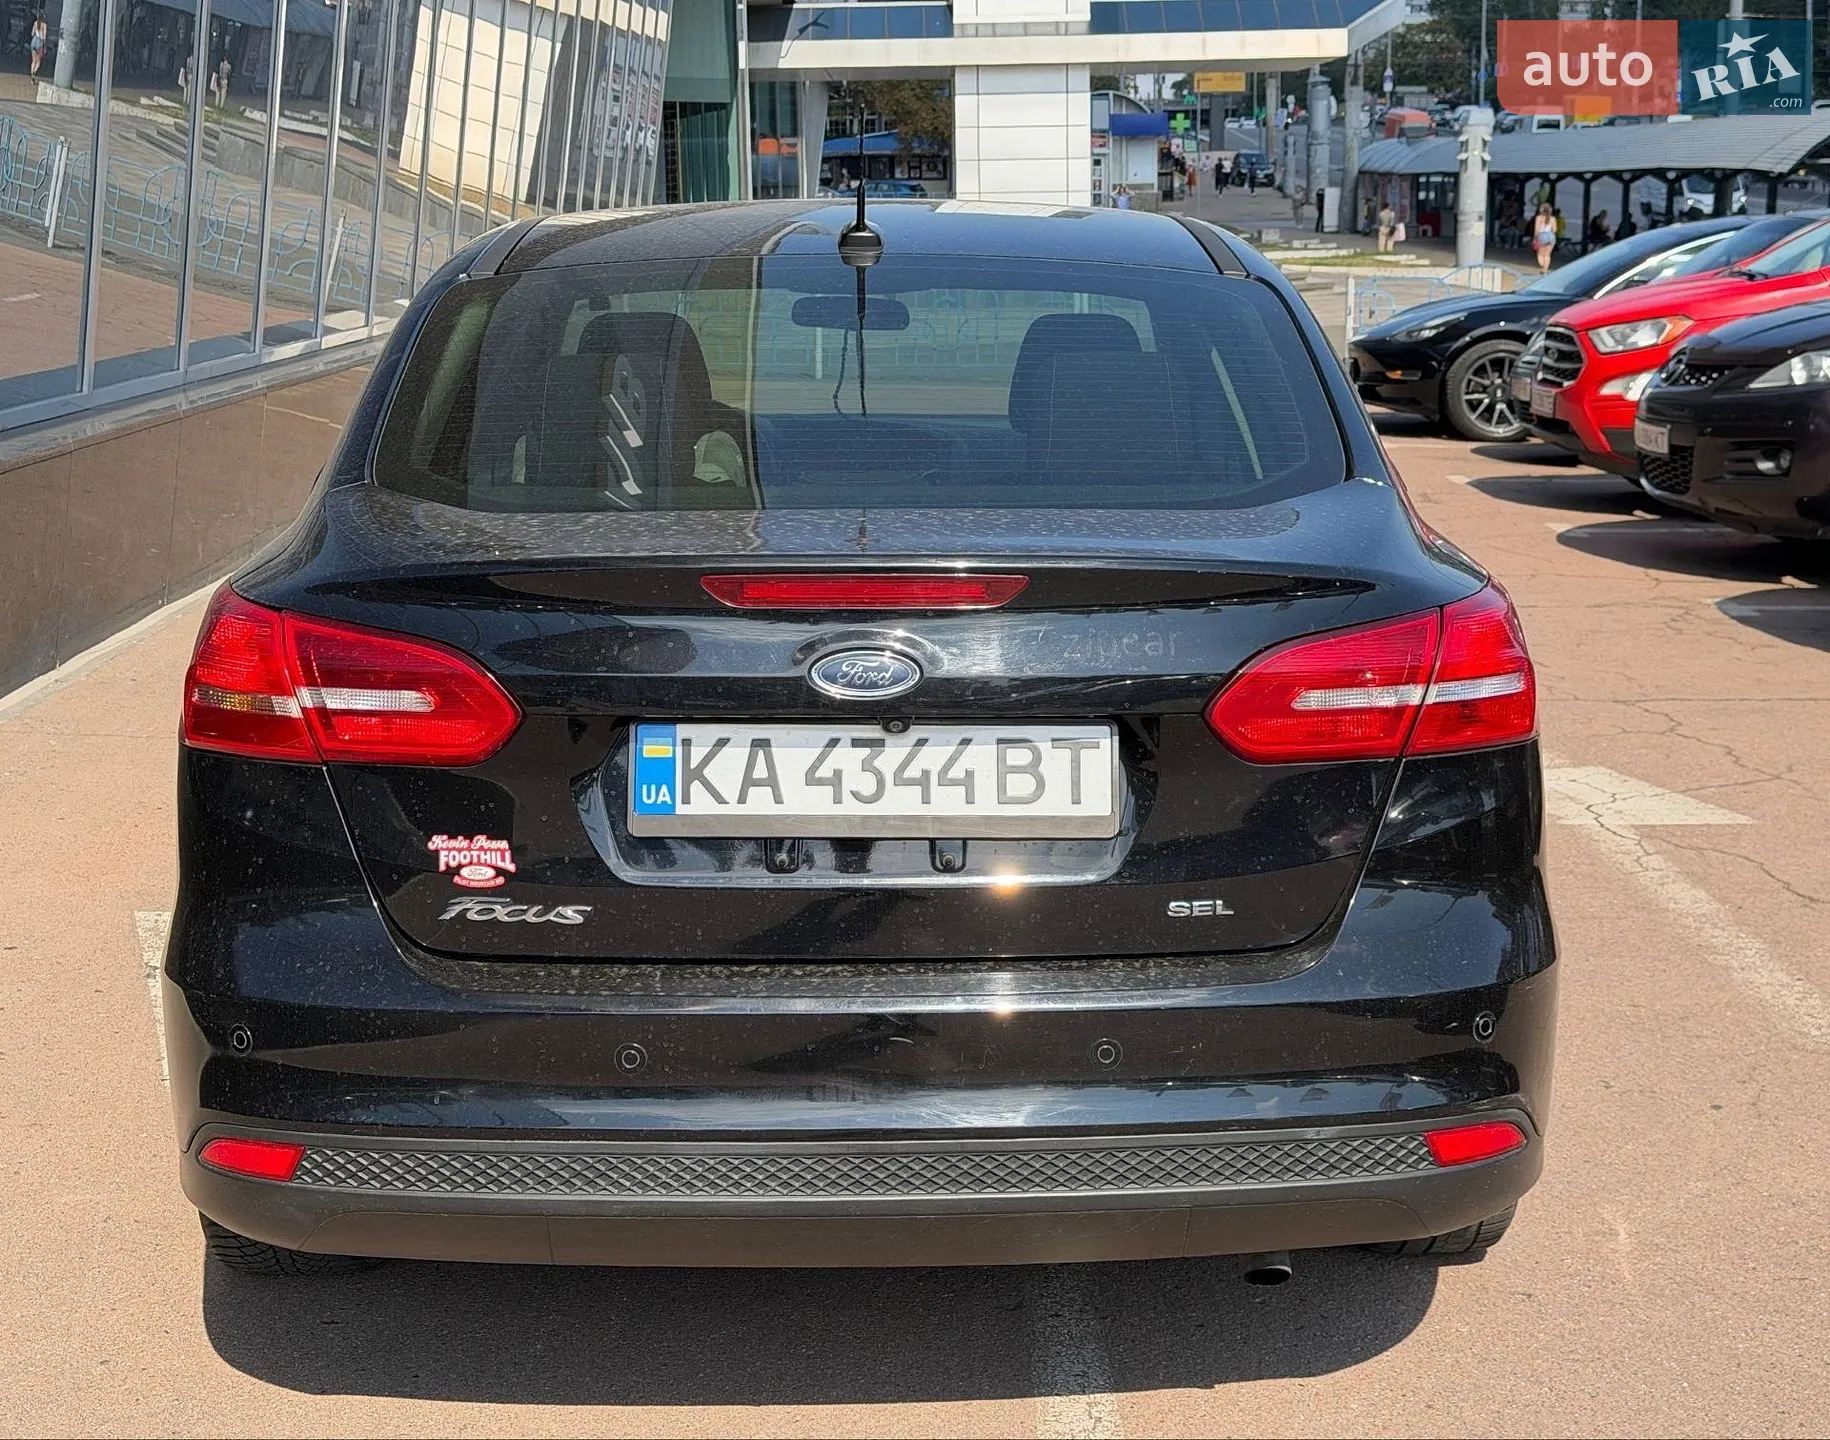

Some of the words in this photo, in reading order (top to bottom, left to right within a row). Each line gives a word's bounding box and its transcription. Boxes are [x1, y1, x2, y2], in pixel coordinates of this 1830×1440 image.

[836, 660, 895, 686] Ford
[681, 738, 785, 805] KA
[804, 738, 976, 805] 4344
[996, 738, 1101, 805] BT
[642, 784, 673, 805] UA
[427, 834, 471, 851] Kevin
[438, 849, 517, 873] FOOTHILL
[1167, 900, 1235, 917] SEL
